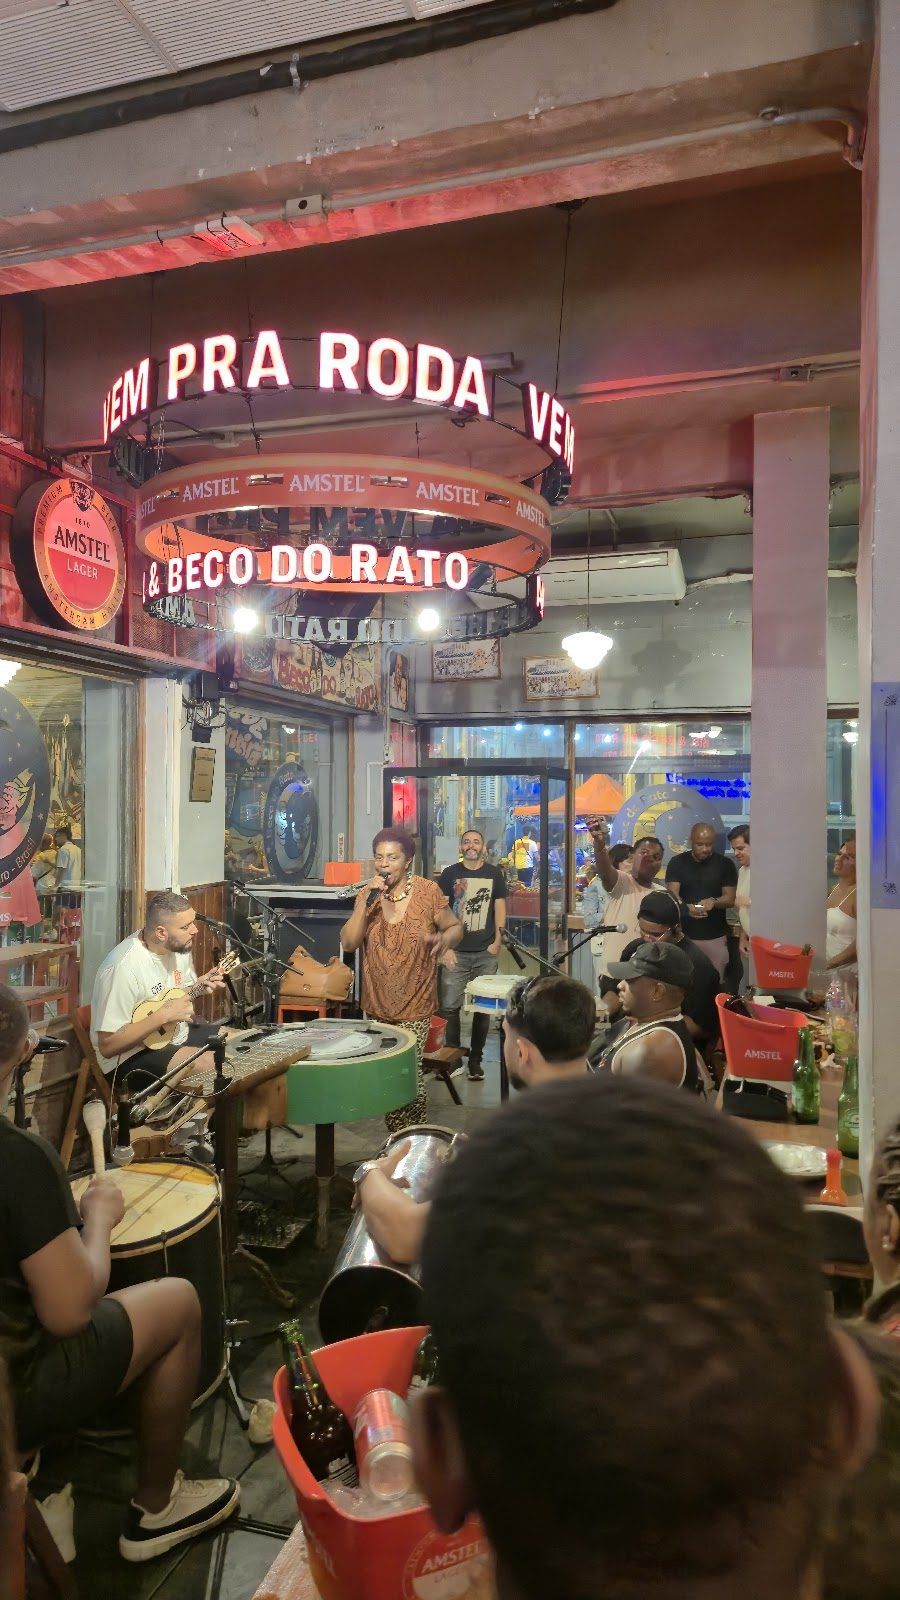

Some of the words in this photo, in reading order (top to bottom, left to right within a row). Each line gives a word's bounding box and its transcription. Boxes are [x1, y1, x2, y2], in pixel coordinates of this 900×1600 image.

[103, 357, 150, 444] VEM
[168, 330, 290, 400] PRA
[320, 332, 490, 416] RODA
[528, 382, 574, 475] VEM
[182, 477, 240, 502] AMSTEL
[289, 473, 366, 493] AMSTEL
[416, 481, 480, 507] AMSTEL
[515, 500, 546, 529] AMSTEL
[53, 525, 112, 563] AMSTEL
[66, 558, 99, 580] LAGER
[167, 546, 254, 595] BECO
[271, 543, 332, 584] DO
[351, 543, 469, 591] RATO
[768, 970, 796, 980] AMSTEL
[744, 1048, 783, 1061] AMSTEL
